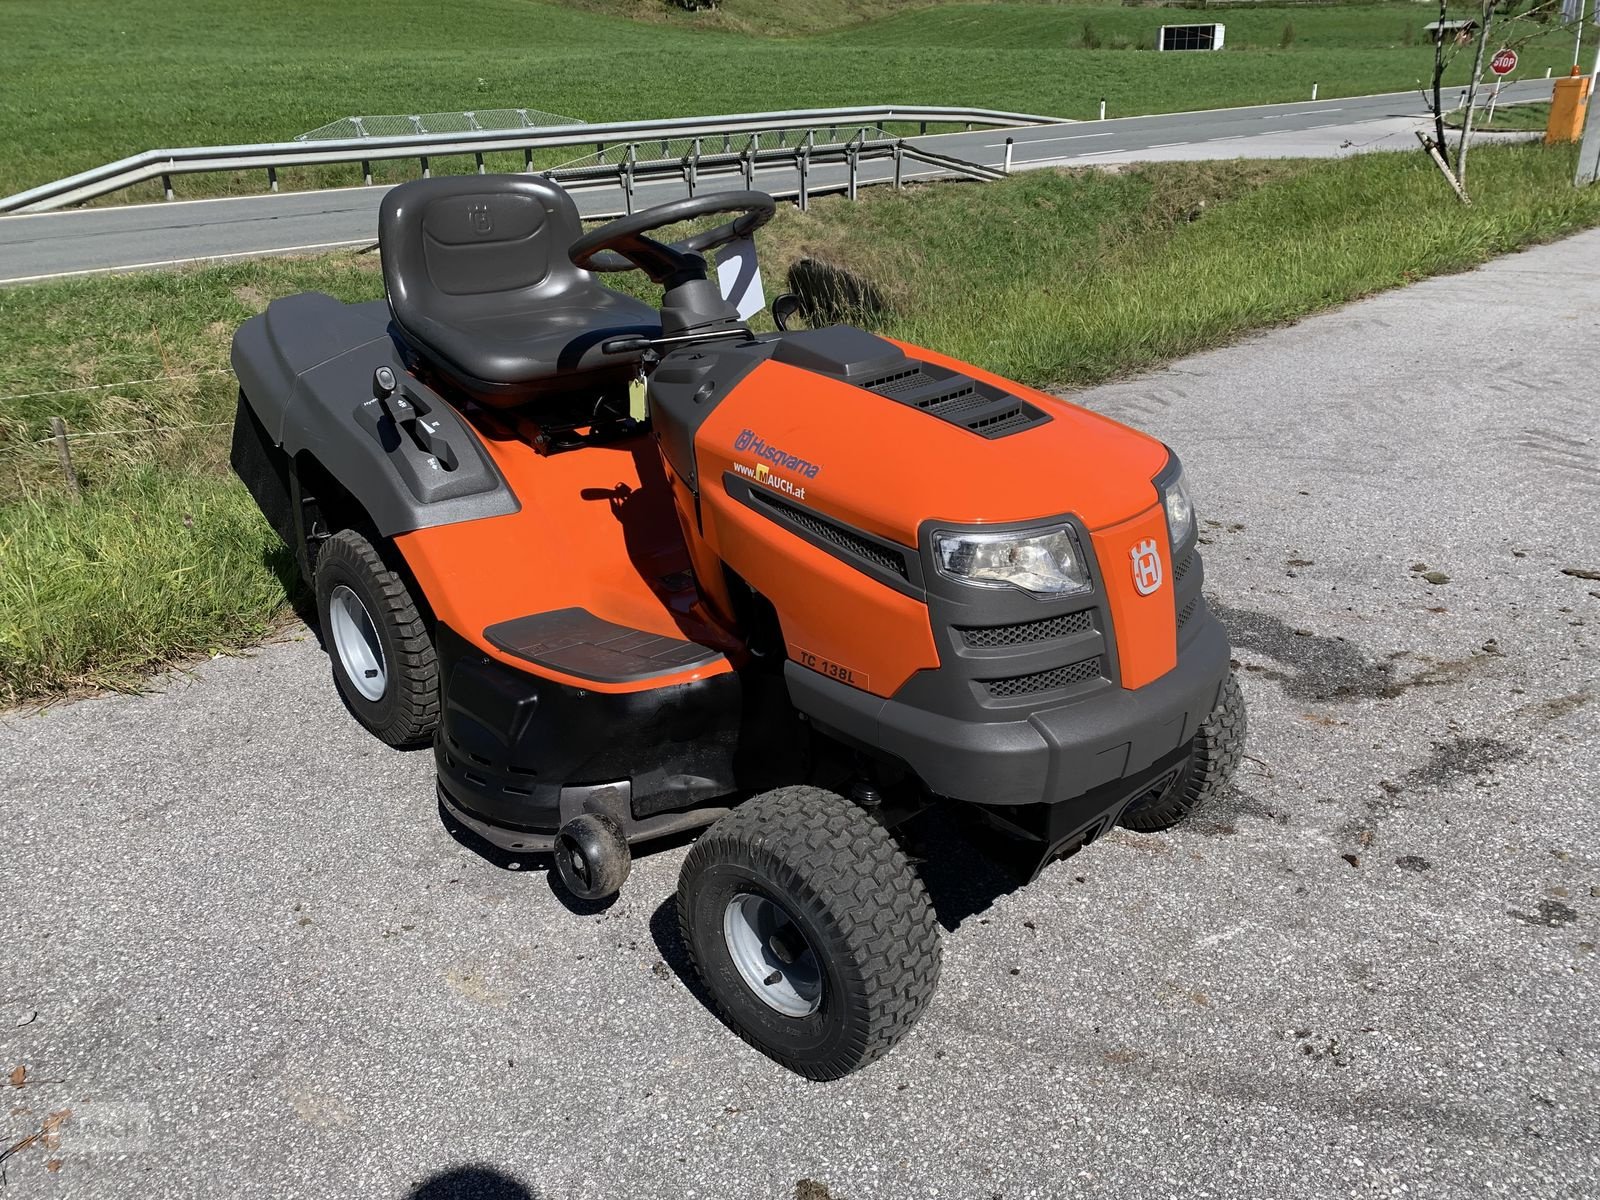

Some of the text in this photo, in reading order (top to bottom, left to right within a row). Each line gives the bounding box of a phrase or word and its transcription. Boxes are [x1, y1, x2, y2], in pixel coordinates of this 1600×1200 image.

[1493, 57, 1515, 68] STOP
[748, 435, 820, 480] Husqvarna
[733, 462, 806, 500] www.MAUCH.at
[801, 651, 855, 683] TC 138L
